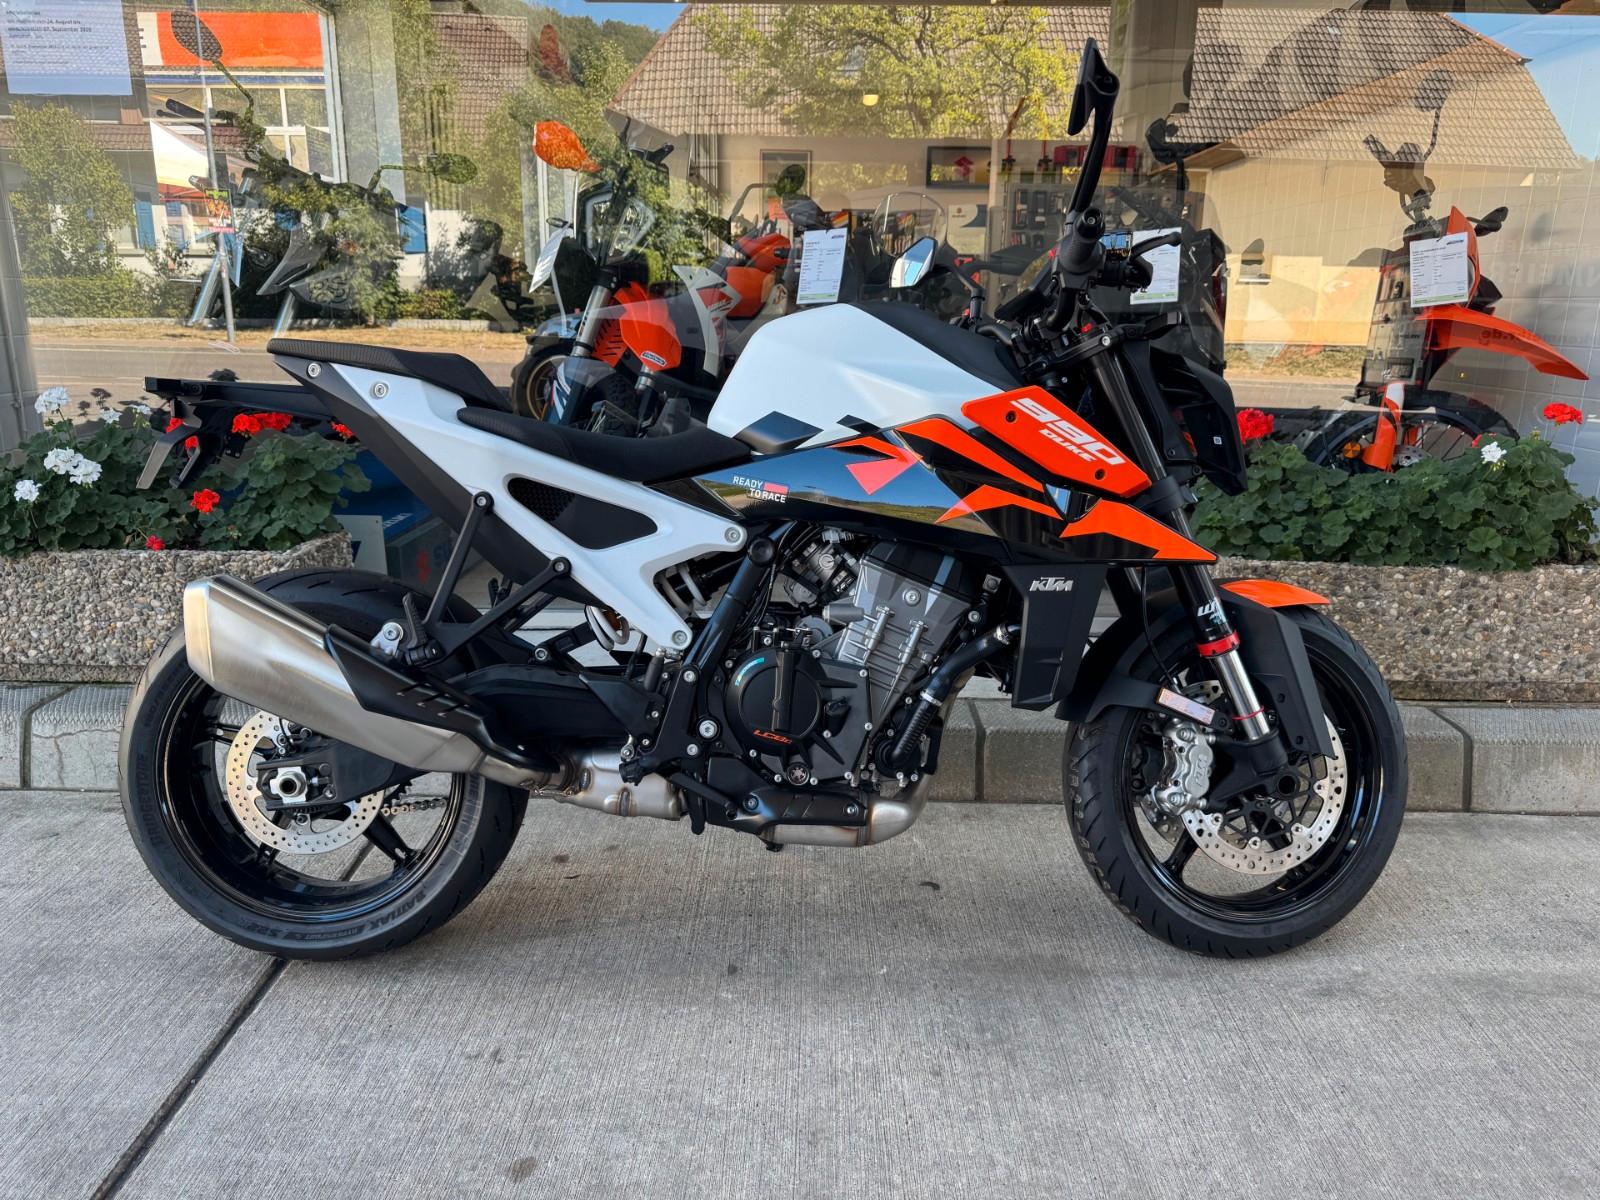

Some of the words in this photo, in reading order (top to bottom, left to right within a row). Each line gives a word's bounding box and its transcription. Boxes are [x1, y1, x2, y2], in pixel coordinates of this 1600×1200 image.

[1010, 397, 1126, 465] 990
[1038, 428, 1097, 462] DUKE
[733, 476, 764, 489] READY
[750, 488, 762, 498] TO
[762, 491, 787, 503] RACE
[1030, 577, 1074, 591] KTM
